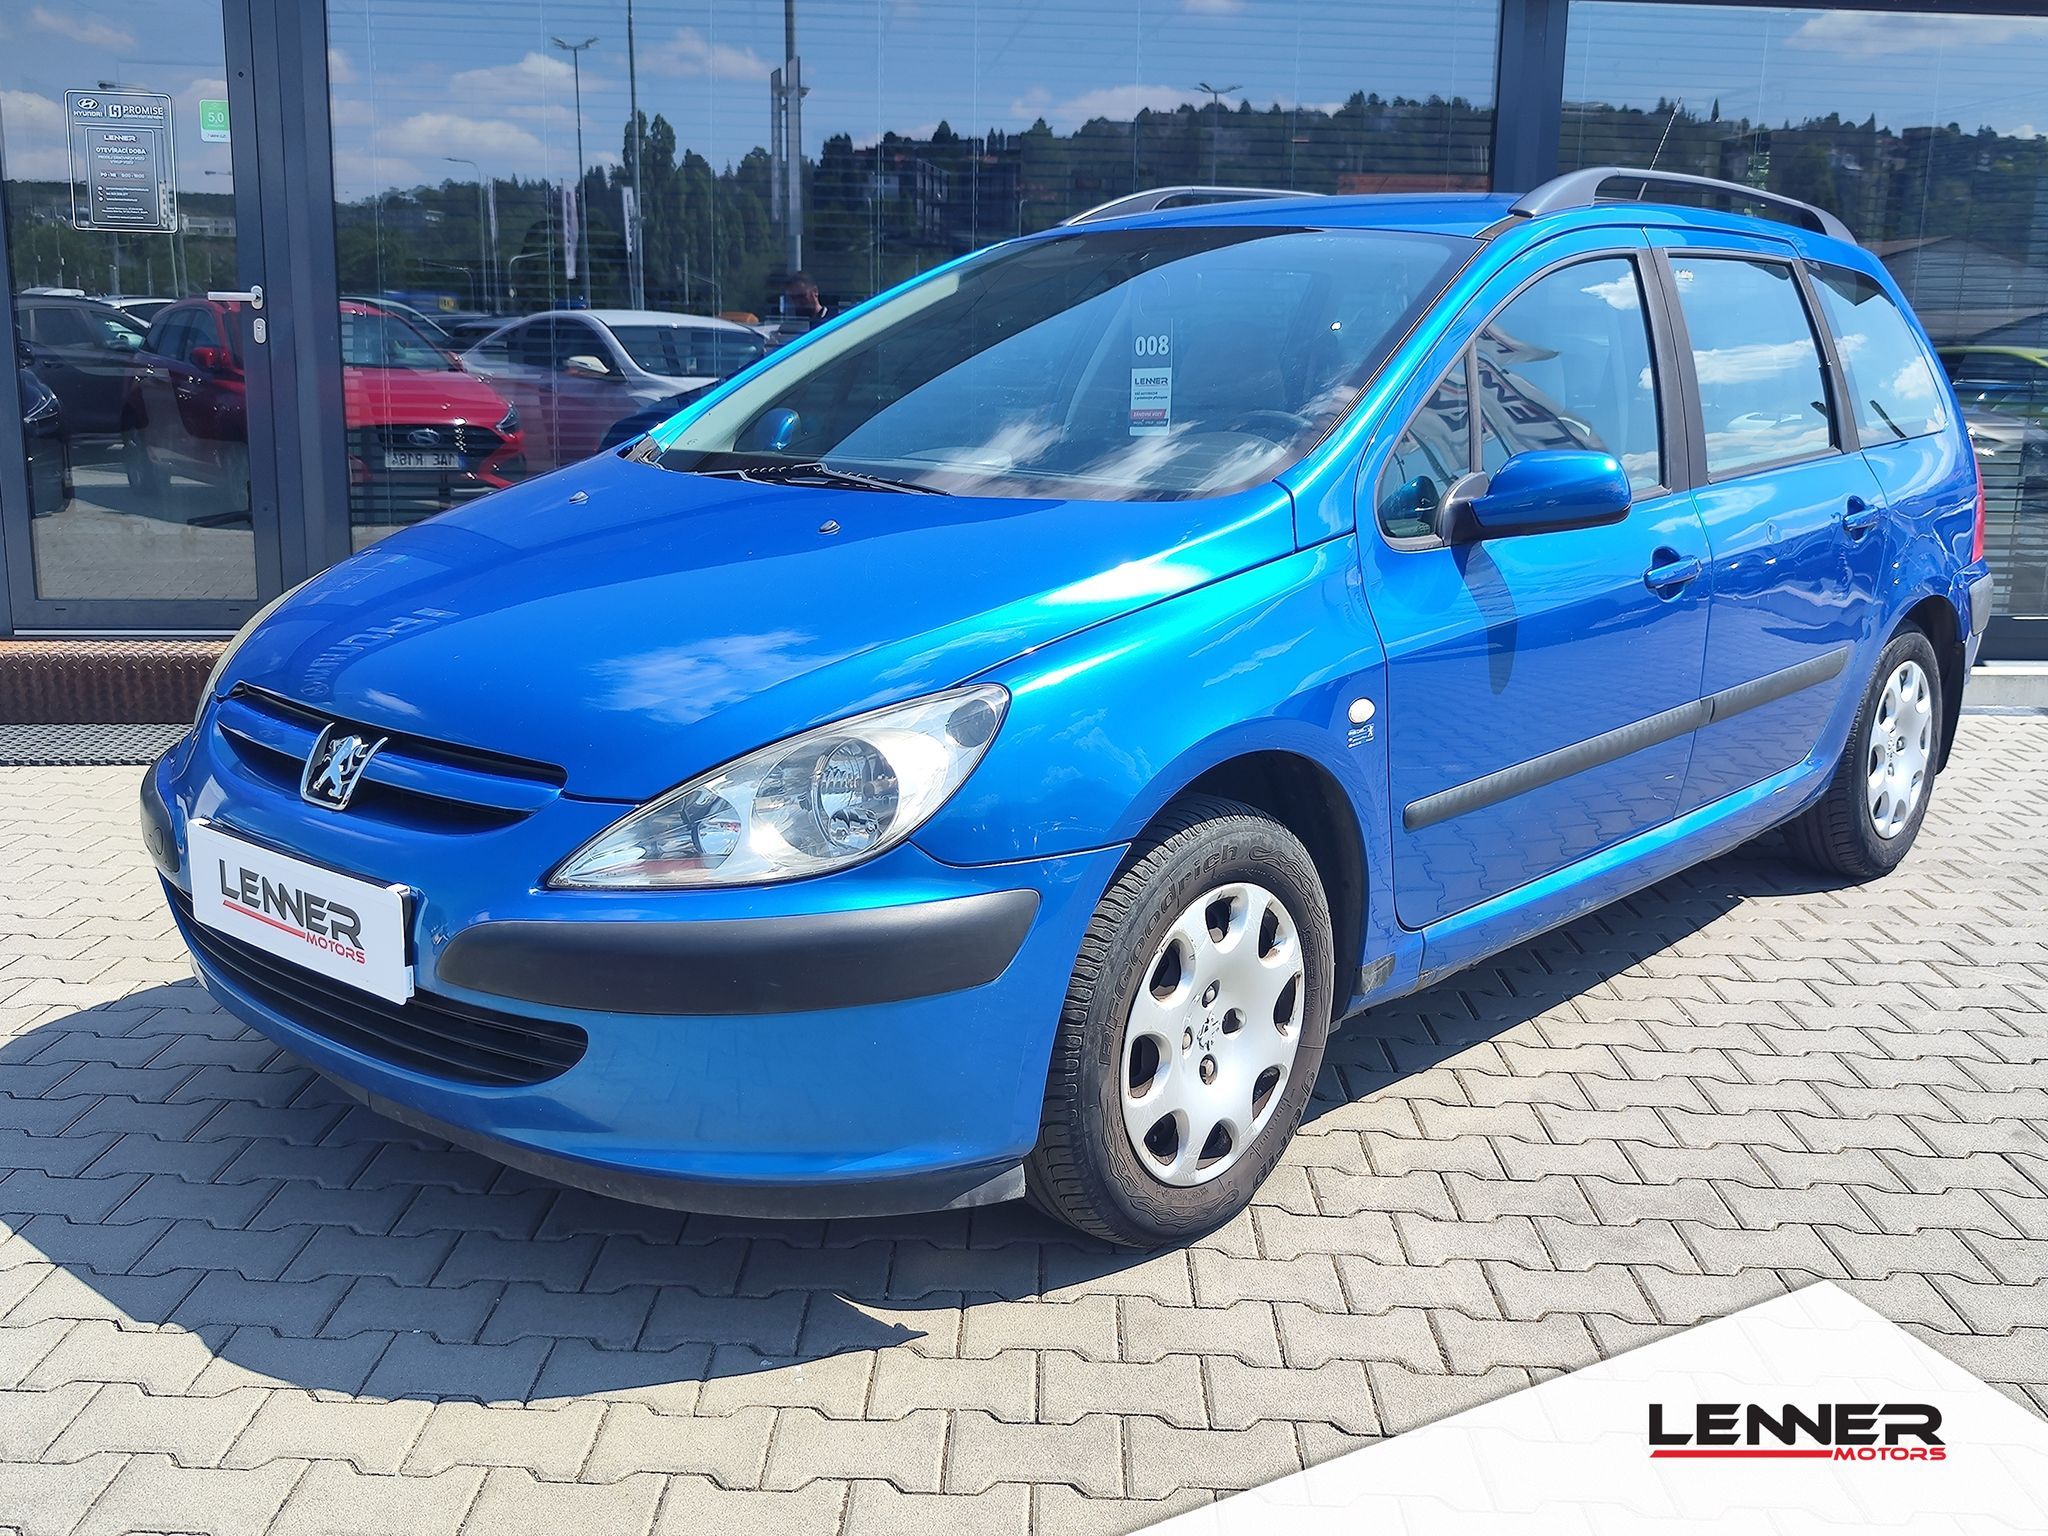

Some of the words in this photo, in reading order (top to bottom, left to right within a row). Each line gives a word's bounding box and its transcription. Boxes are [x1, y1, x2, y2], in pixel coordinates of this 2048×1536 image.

[123, 105, 164, 116] PROMISE
[103, 134, 137, 142] LENNER
[129, 148, 147, 156] DOBA
[1135, 335, 1170, 357] 008
[1135, 377, 1169, 386] LENNER
[218, 858, 365, 951] LENNER
[305, 931, 366, 965] MOTORS
